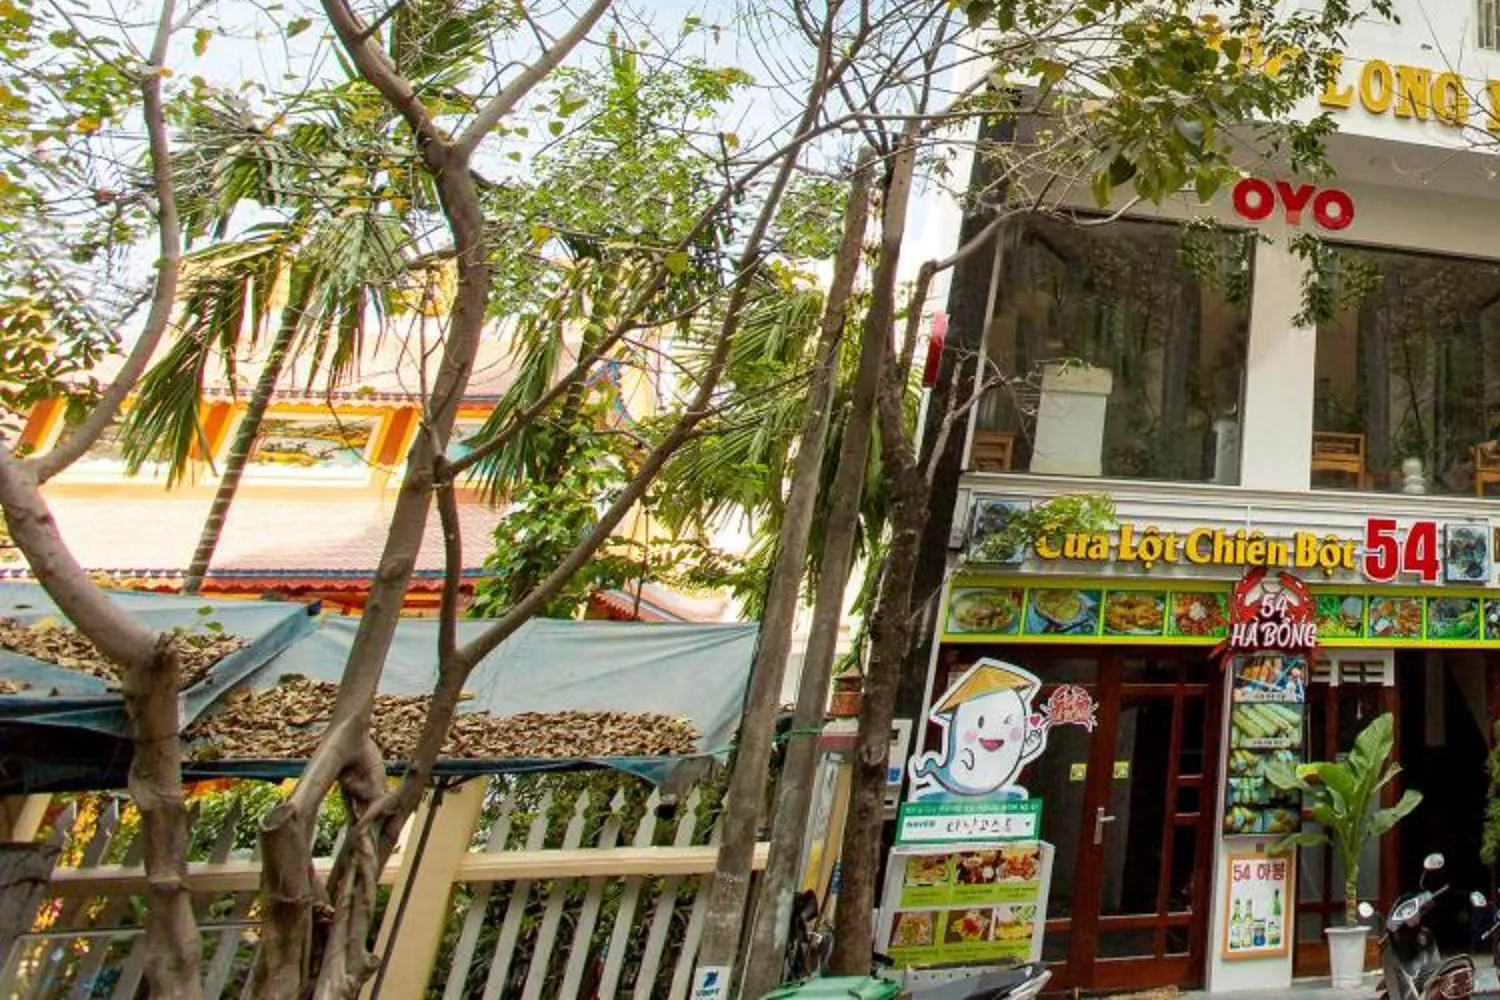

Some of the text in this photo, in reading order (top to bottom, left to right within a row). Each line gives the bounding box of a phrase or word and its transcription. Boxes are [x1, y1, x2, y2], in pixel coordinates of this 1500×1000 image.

[1318, 50, 1469, 128] LONG
[1231, 176, 1355, 230] OYO
[1184, 526, 1289, 568] Chiên
[1363, 516, 1440, 583] 54
[1260, 593, 1289, 619] 54
